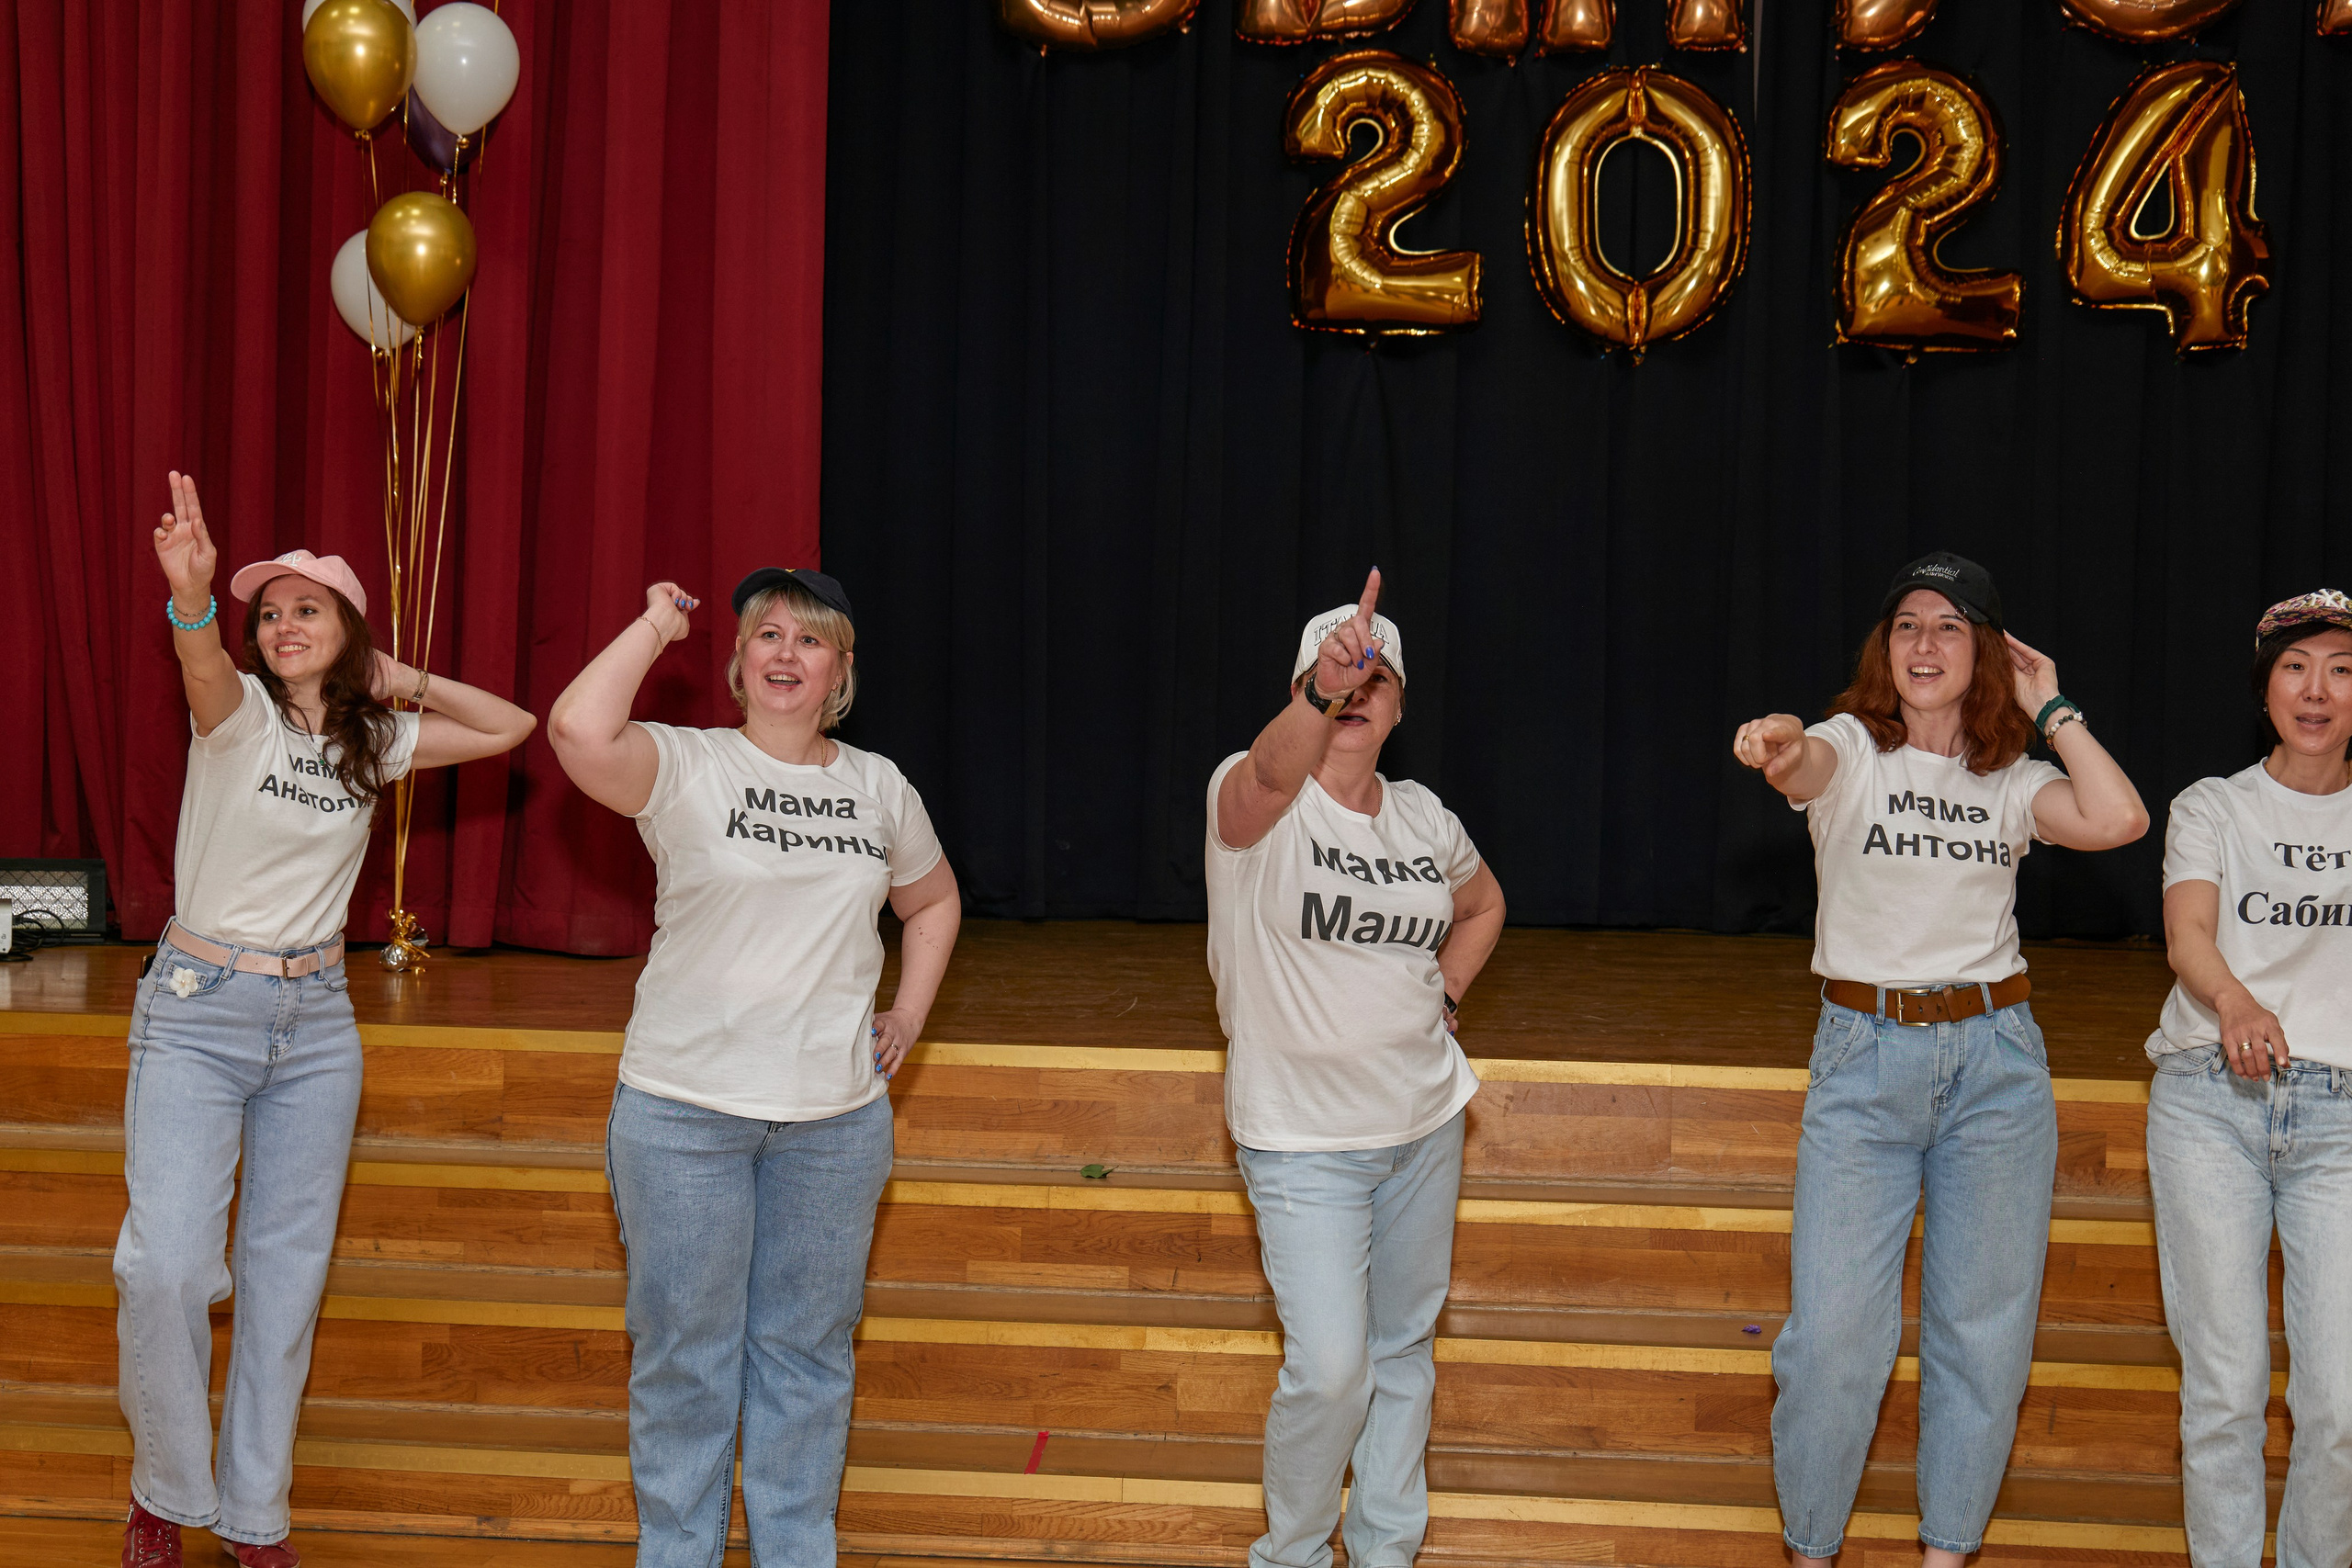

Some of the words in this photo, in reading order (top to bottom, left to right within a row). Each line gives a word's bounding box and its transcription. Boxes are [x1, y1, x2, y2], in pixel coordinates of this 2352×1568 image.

[1283, 48, 2274, 363] 2024
[725, 807, 889, 866] Карины
[1862, 823, 2012, 868] Антона
